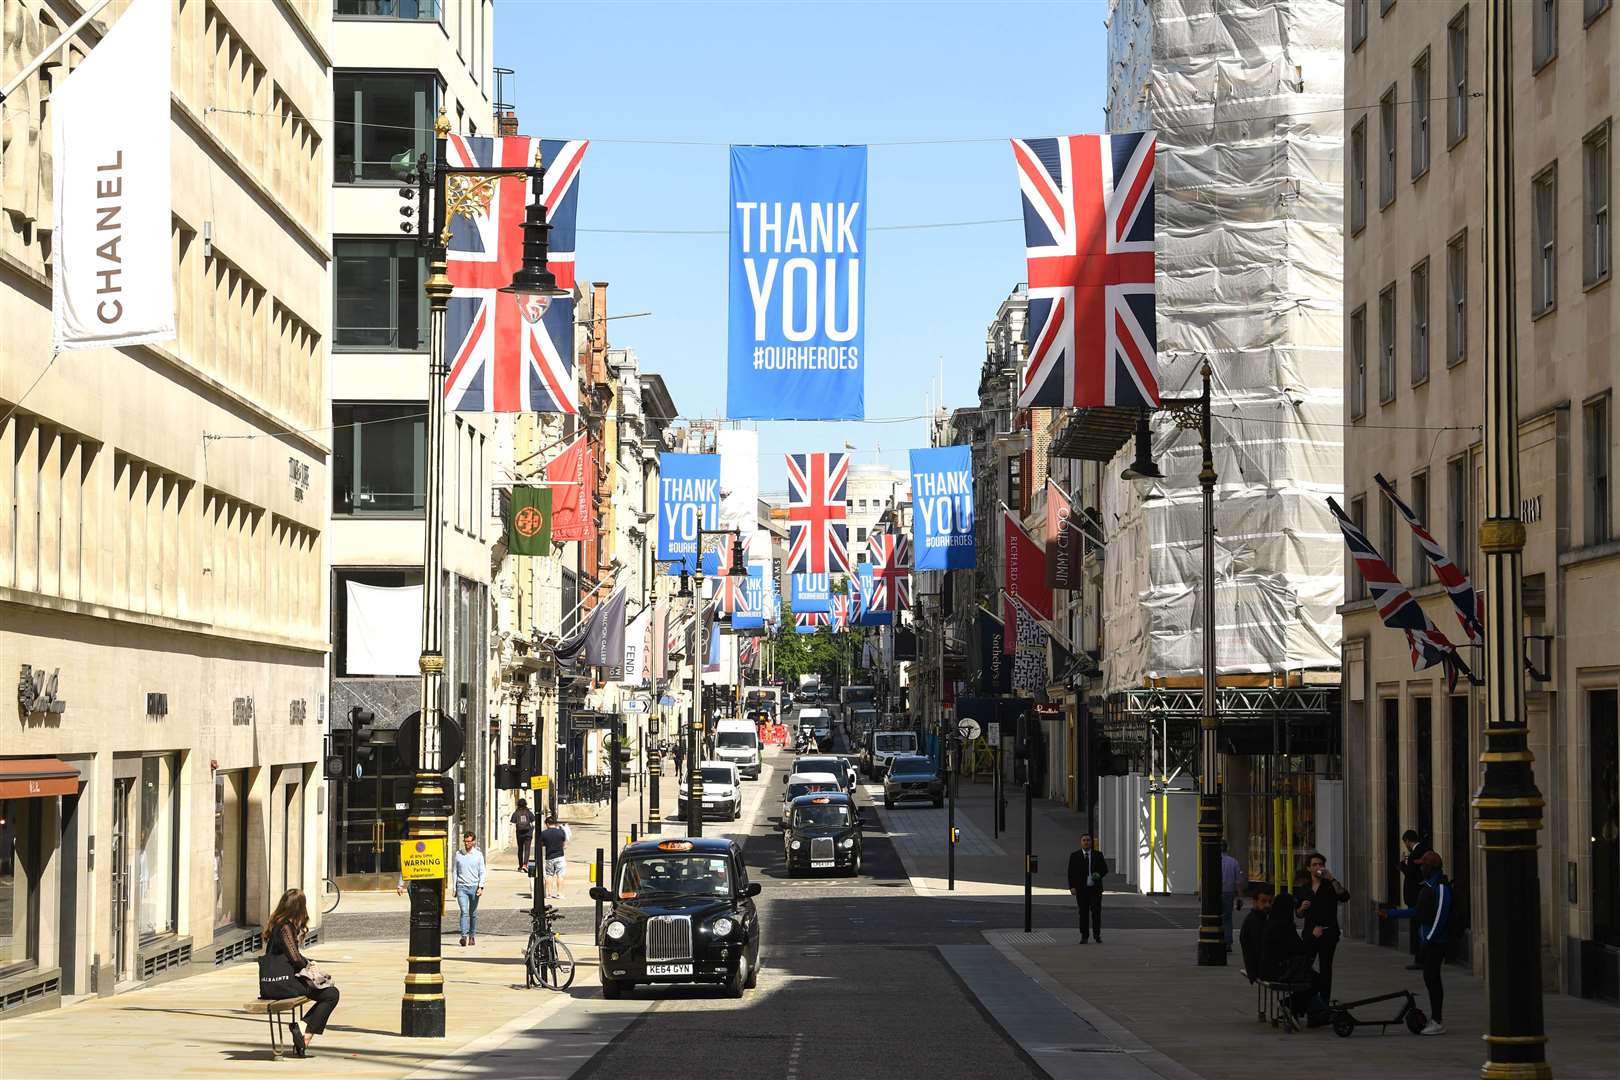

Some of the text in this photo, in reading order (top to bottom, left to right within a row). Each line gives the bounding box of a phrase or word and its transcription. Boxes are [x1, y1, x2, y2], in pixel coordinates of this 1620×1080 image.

[96, 150, 123, 324] CHANEL
[736, 202, 860, 253] THANK
[743, 257, 859, 342] YOU
[753, 346, 859, 370] #OURHEROES
[662, 478, 718, 502] THANK
[914, 470, 970, 496] THANK
[664, 503, 717, 541] YOU
[919, 496, 972, 535] YOU
[926, 534, 973, 547] #OURHEROES
[1056, 507, 1070, 585] JIMMY CHOO
[1010, 536, 1018, 580] RICHARD
[601, 611, 609, 637] HALCYON
[625, 645, 636, 675] FENDI
[404, 859, 440, 867] WARNING
[649, 964, 690, 974] KE64 GYN
